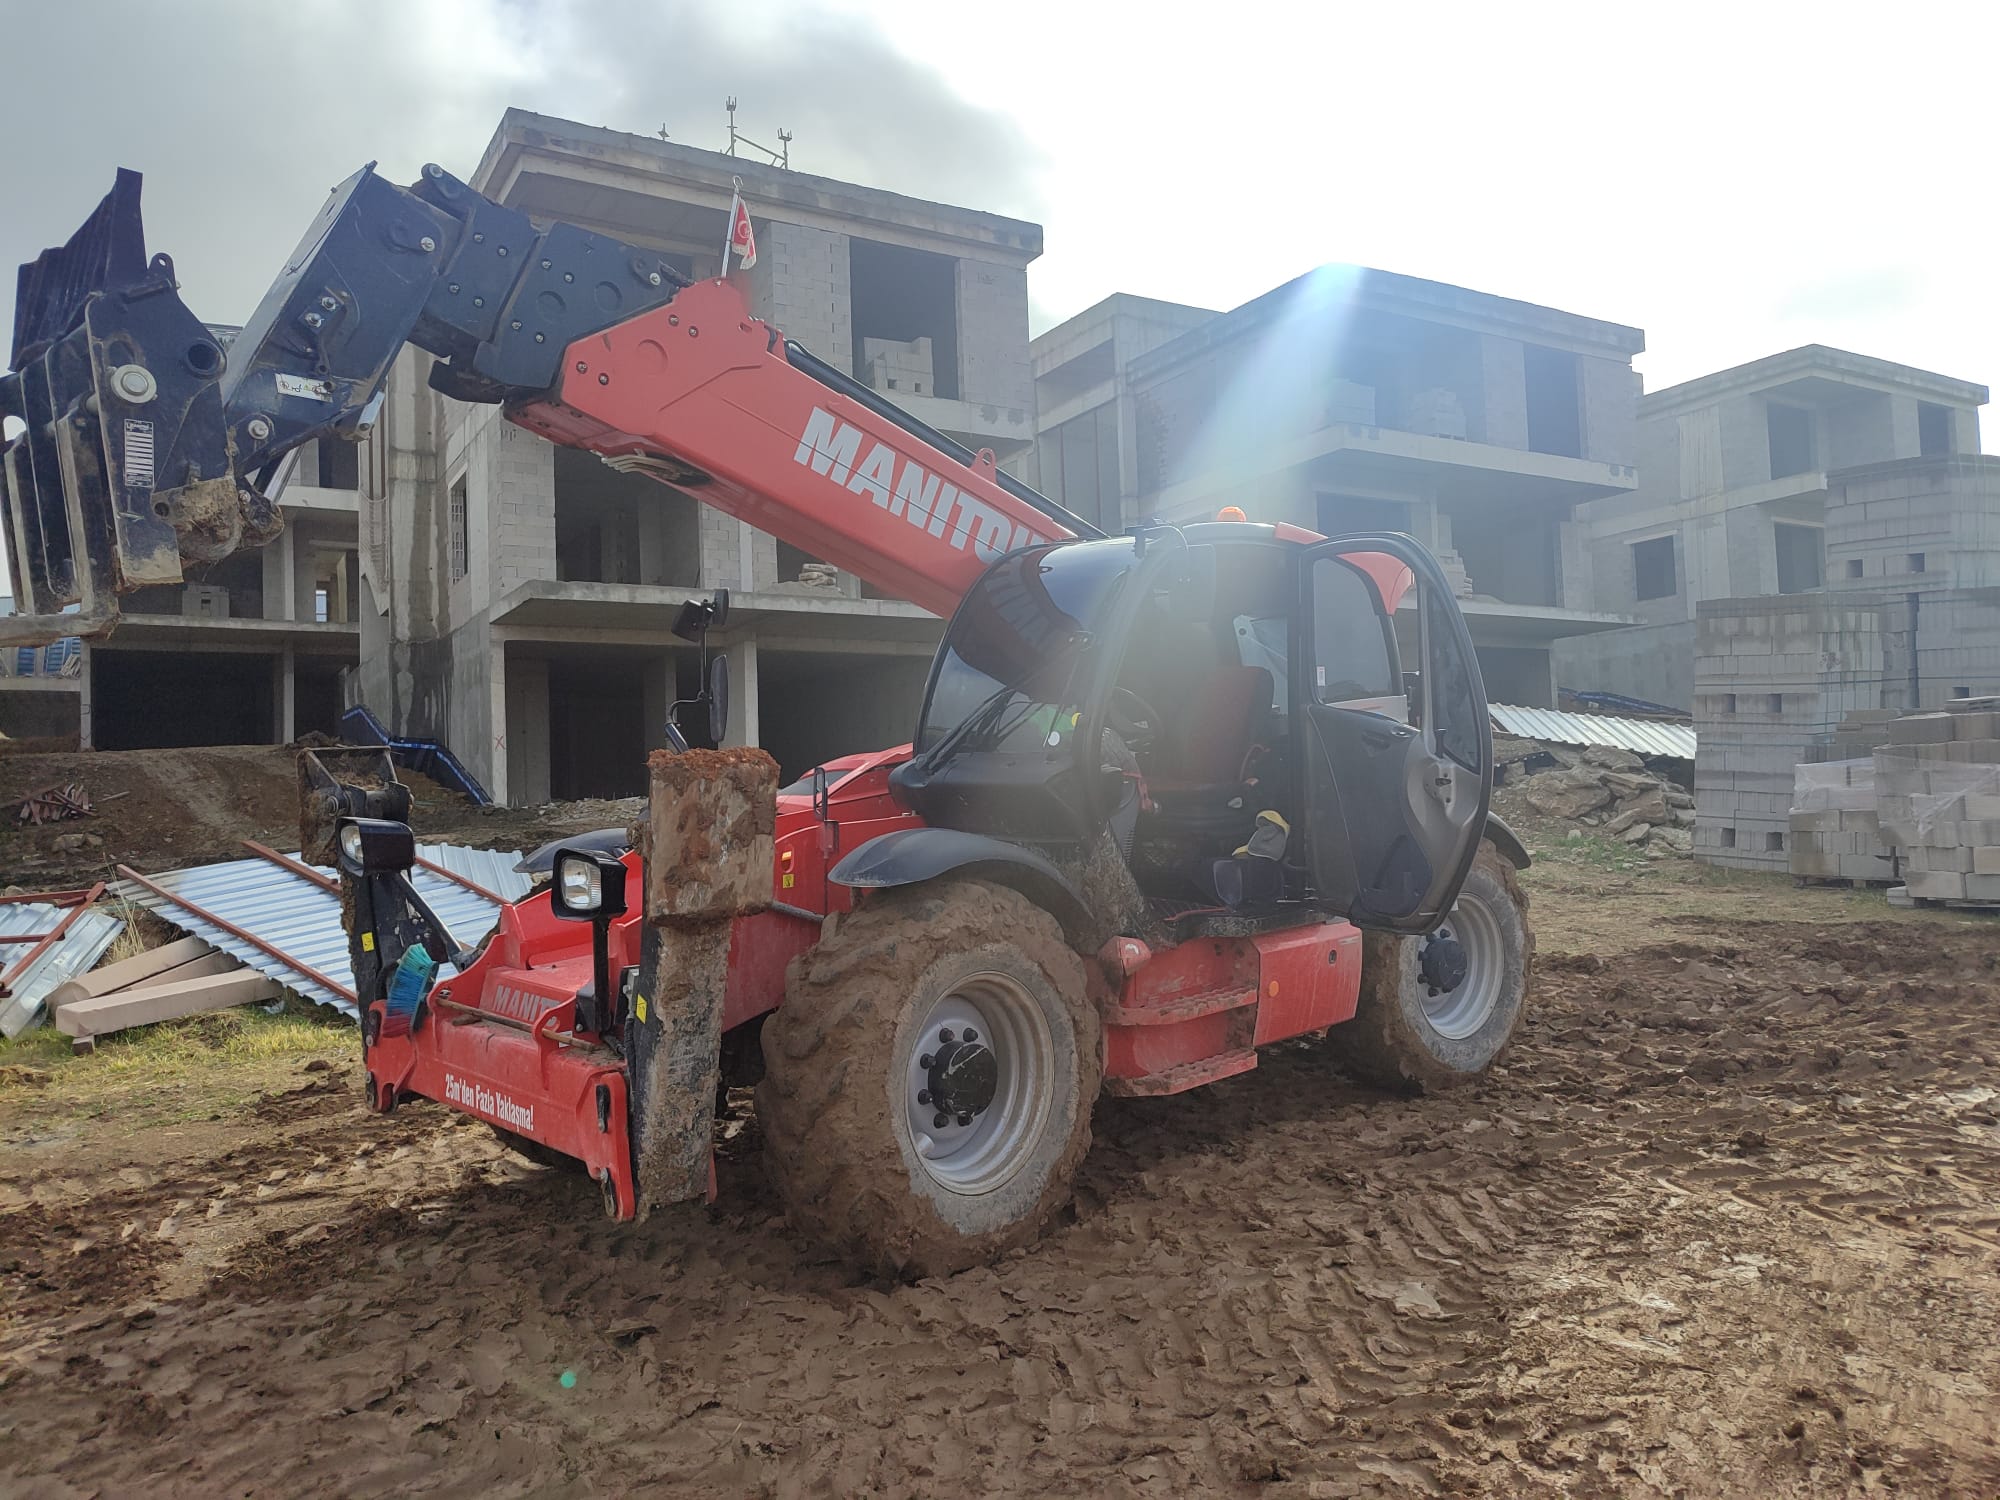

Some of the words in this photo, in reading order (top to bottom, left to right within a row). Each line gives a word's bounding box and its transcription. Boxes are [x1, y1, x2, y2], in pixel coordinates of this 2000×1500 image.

[493, 984, 560, 1027] MANIT
[445, 1073, 474, 1107] 25m'den
[475, 1084, 494, 1115] Fazla
[496, 1091, 534, 1132] Yaklaşma!
